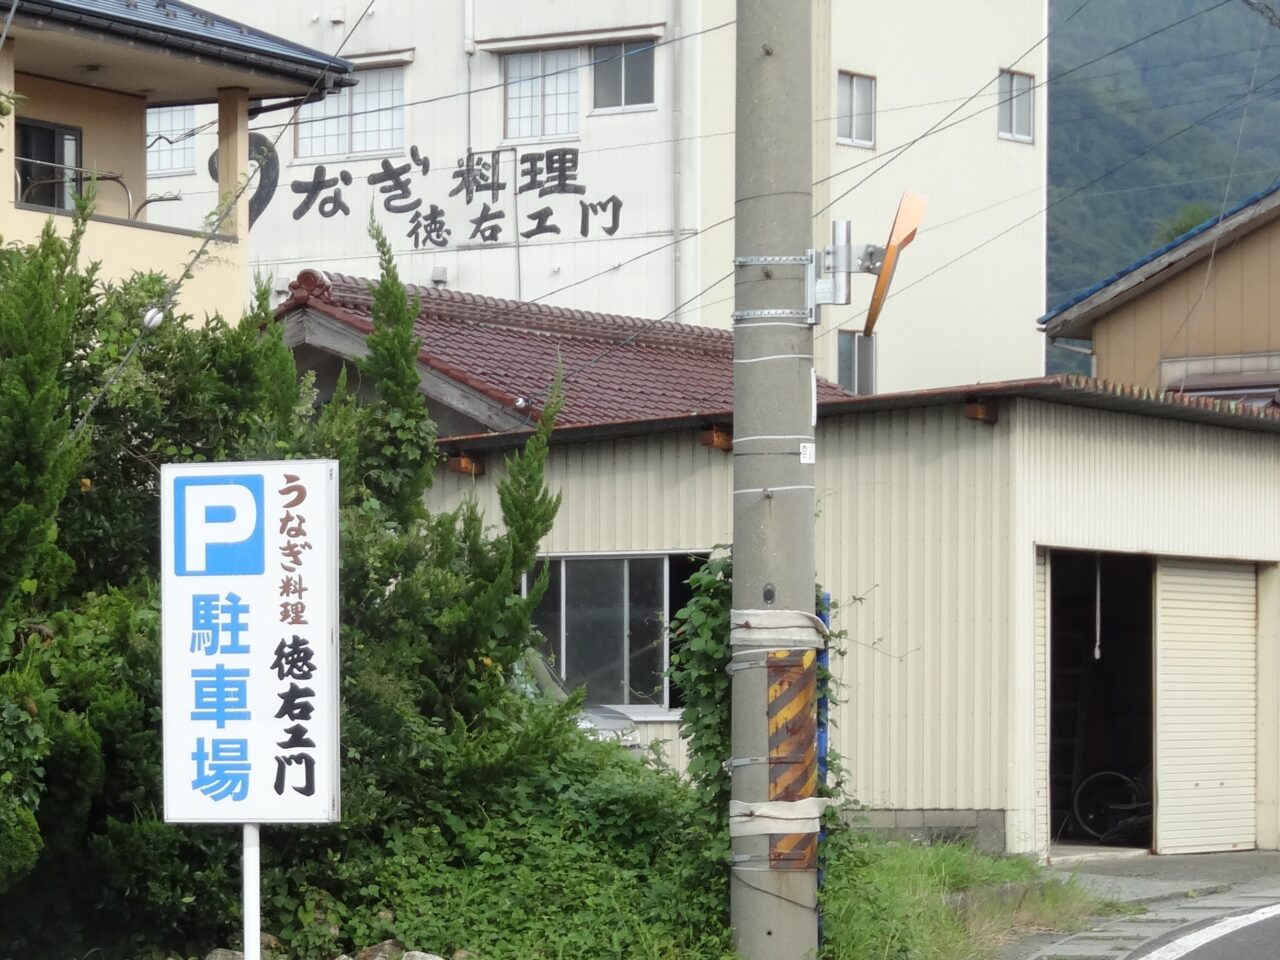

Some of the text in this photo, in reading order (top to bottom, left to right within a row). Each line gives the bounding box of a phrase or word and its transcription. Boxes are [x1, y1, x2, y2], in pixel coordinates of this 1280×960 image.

[184, 483, 257, 572] P
[278, 474, 312, 625] うなぎ料理
[190, 592, 252, 802] 駐車場
